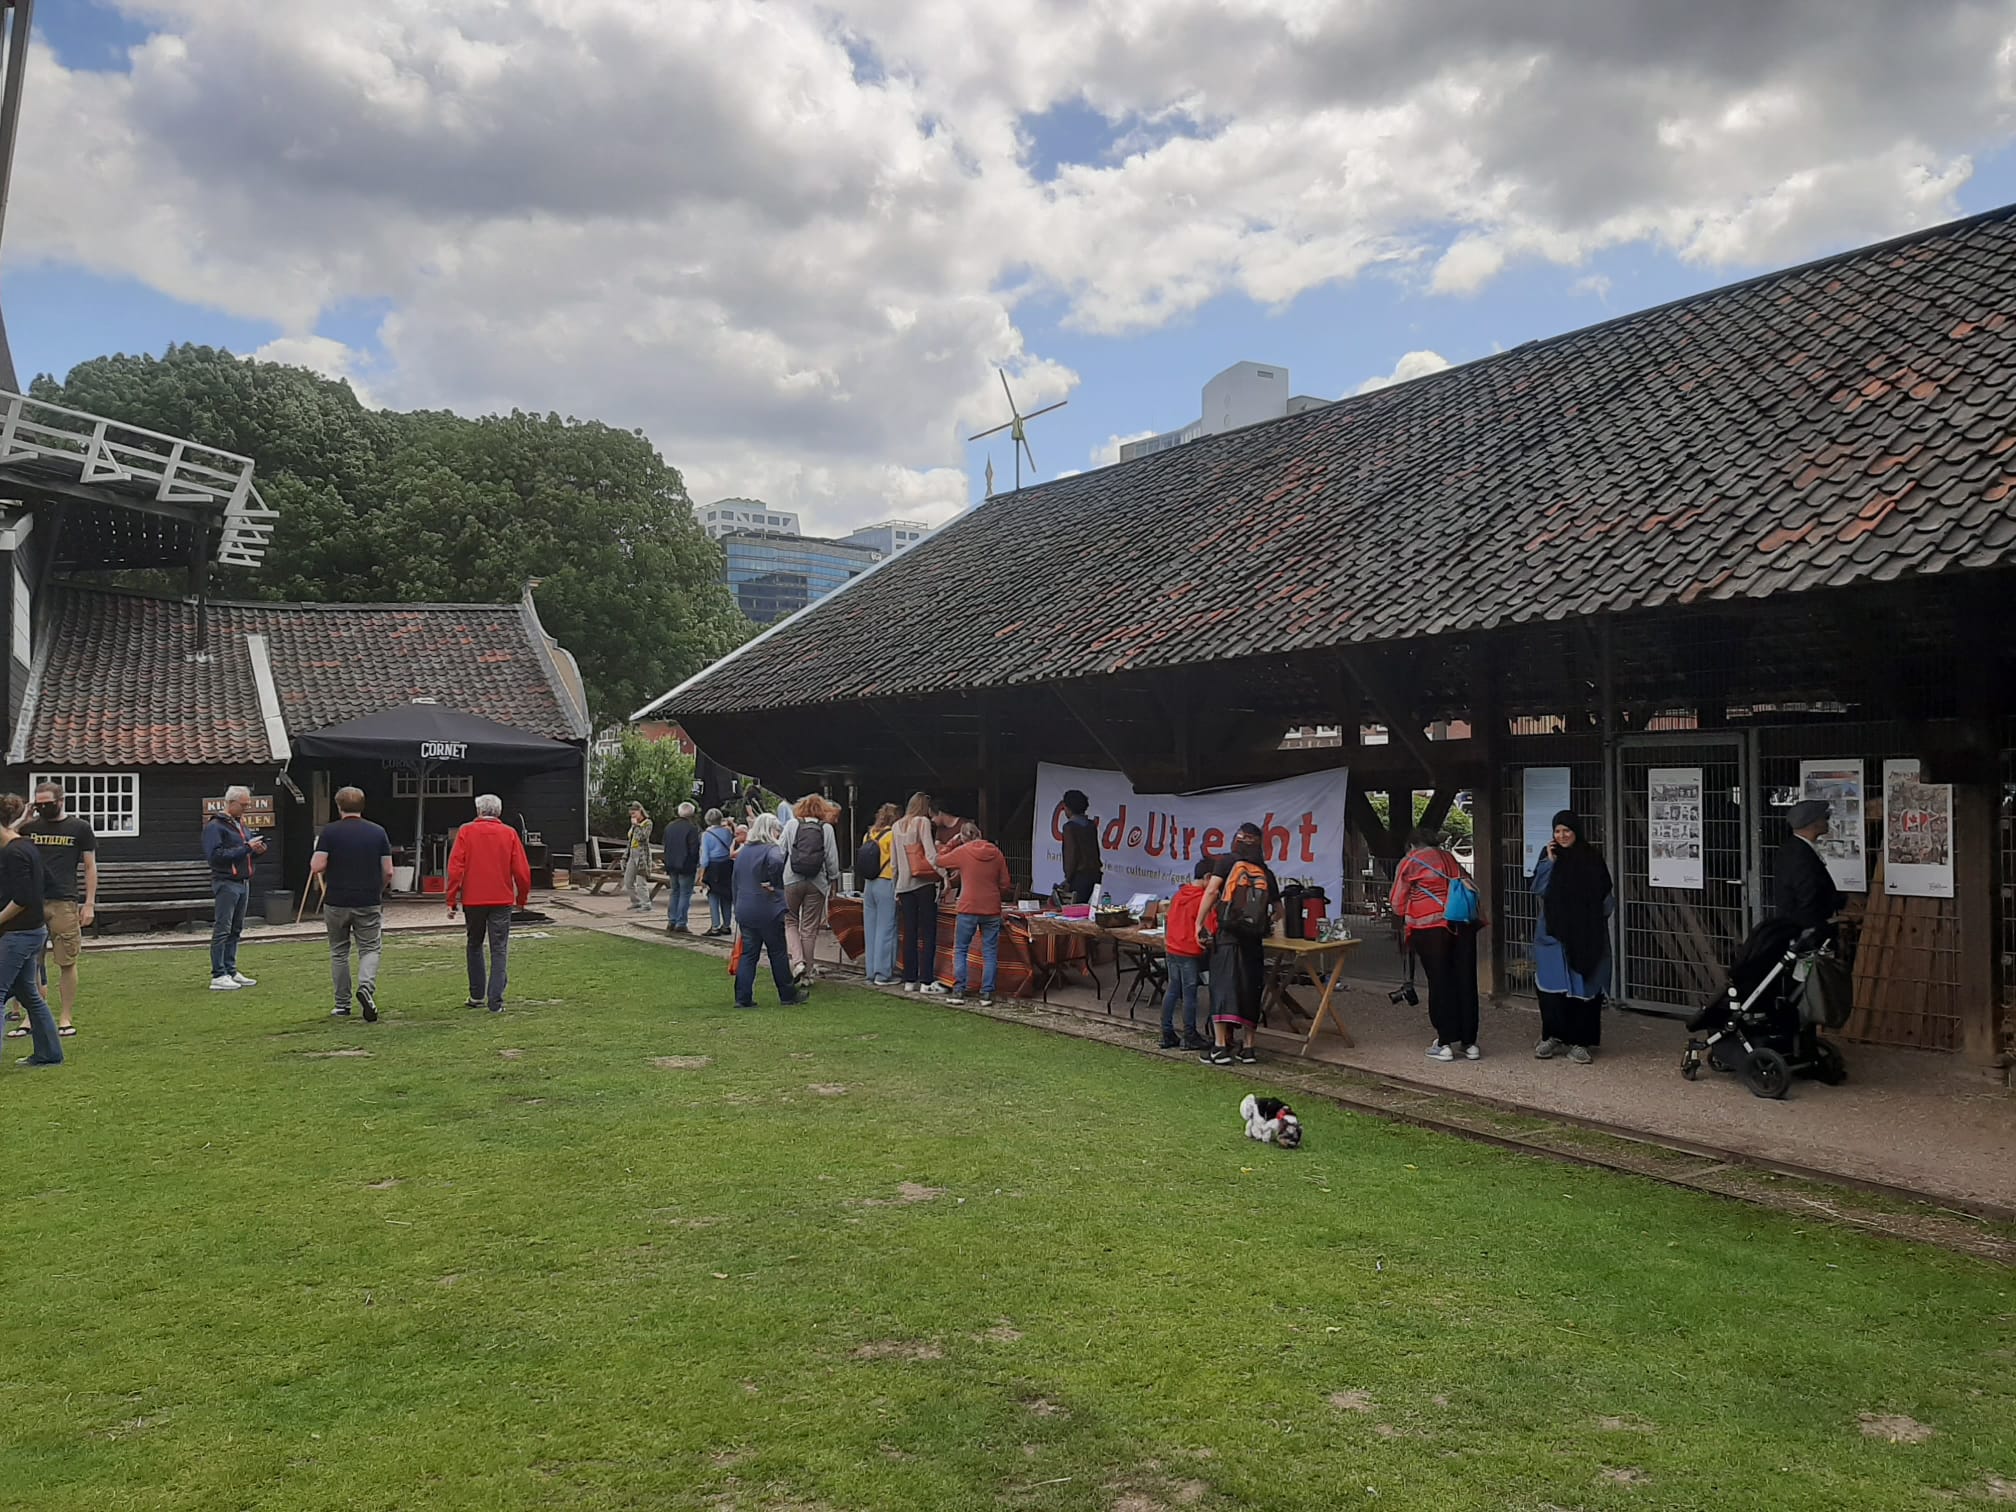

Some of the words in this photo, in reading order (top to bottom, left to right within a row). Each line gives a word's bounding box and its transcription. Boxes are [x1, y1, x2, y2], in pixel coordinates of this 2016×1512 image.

[421, 742, 468, 759] CORNET
[255, 799, 268, 808] IN
[1144, 811, 1318, 862] Utreht
